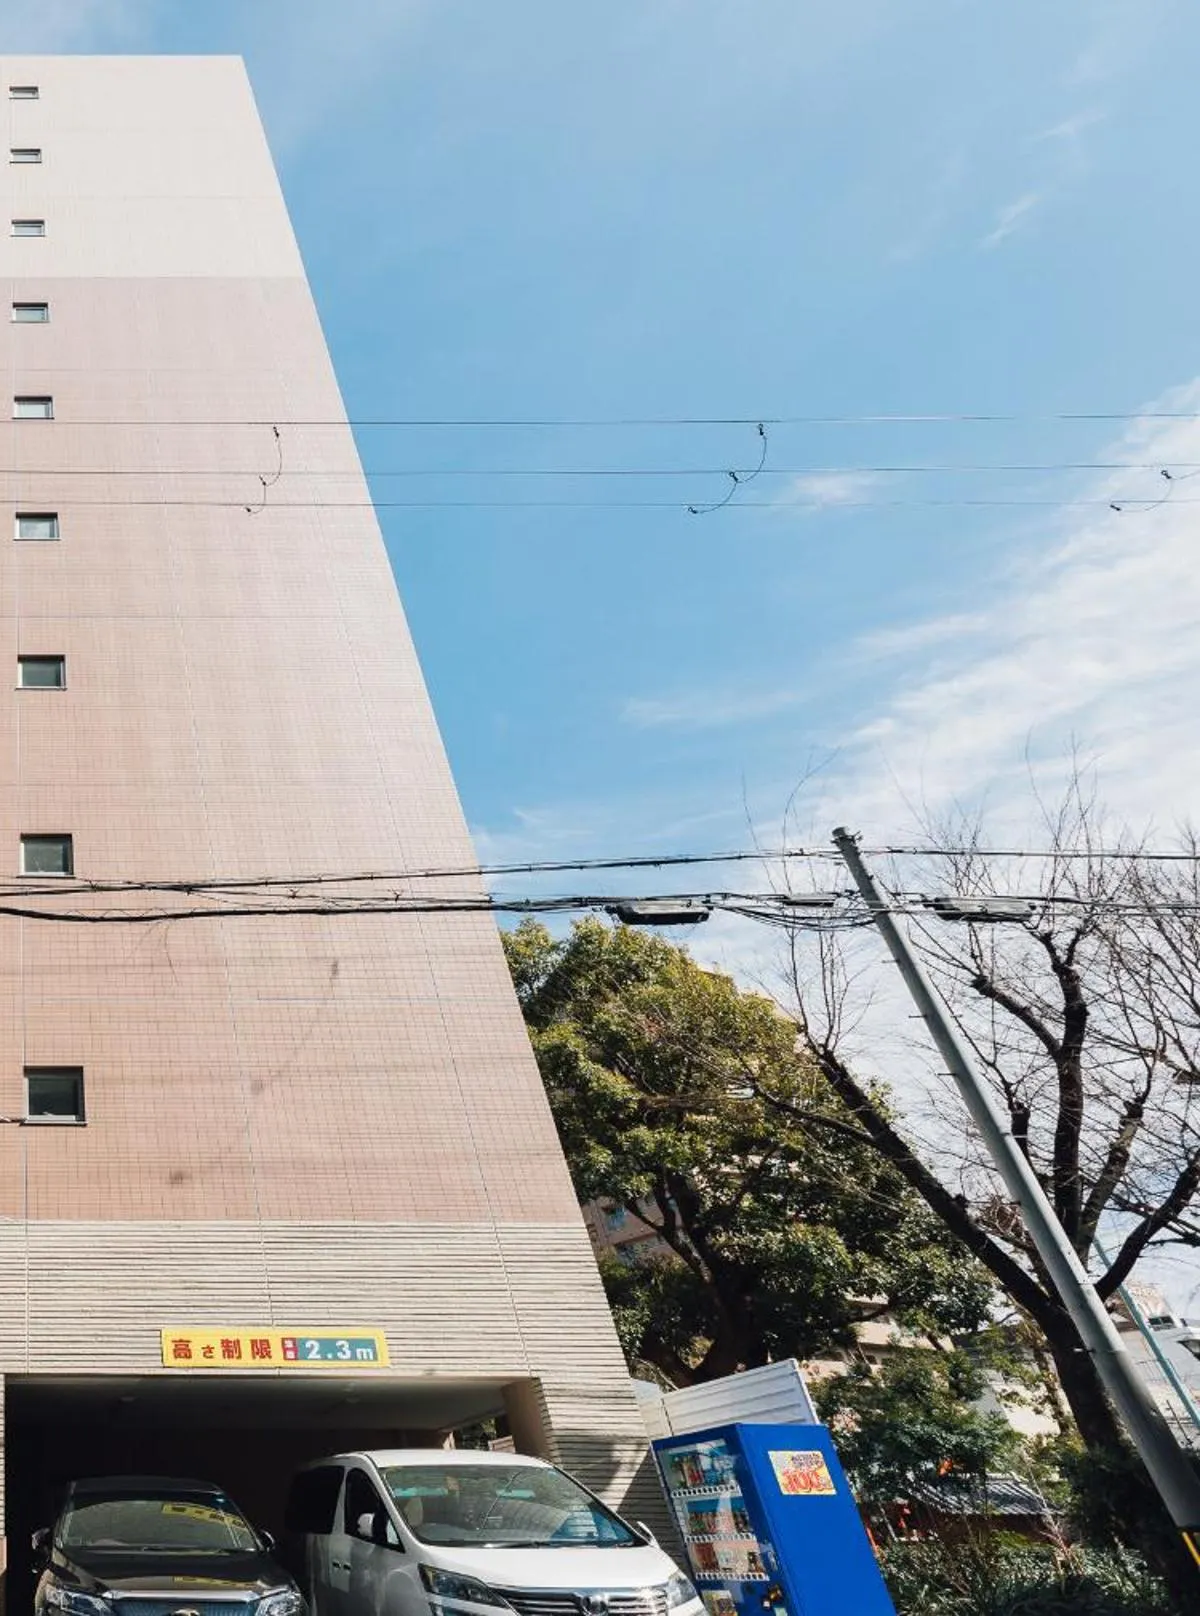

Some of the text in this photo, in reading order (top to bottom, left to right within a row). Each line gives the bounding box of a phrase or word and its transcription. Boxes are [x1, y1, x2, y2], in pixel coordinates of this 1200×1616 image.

[171, 1339, 272, 1360] 高さ制限
[305, 1340, 374, 1360] 2.3m
